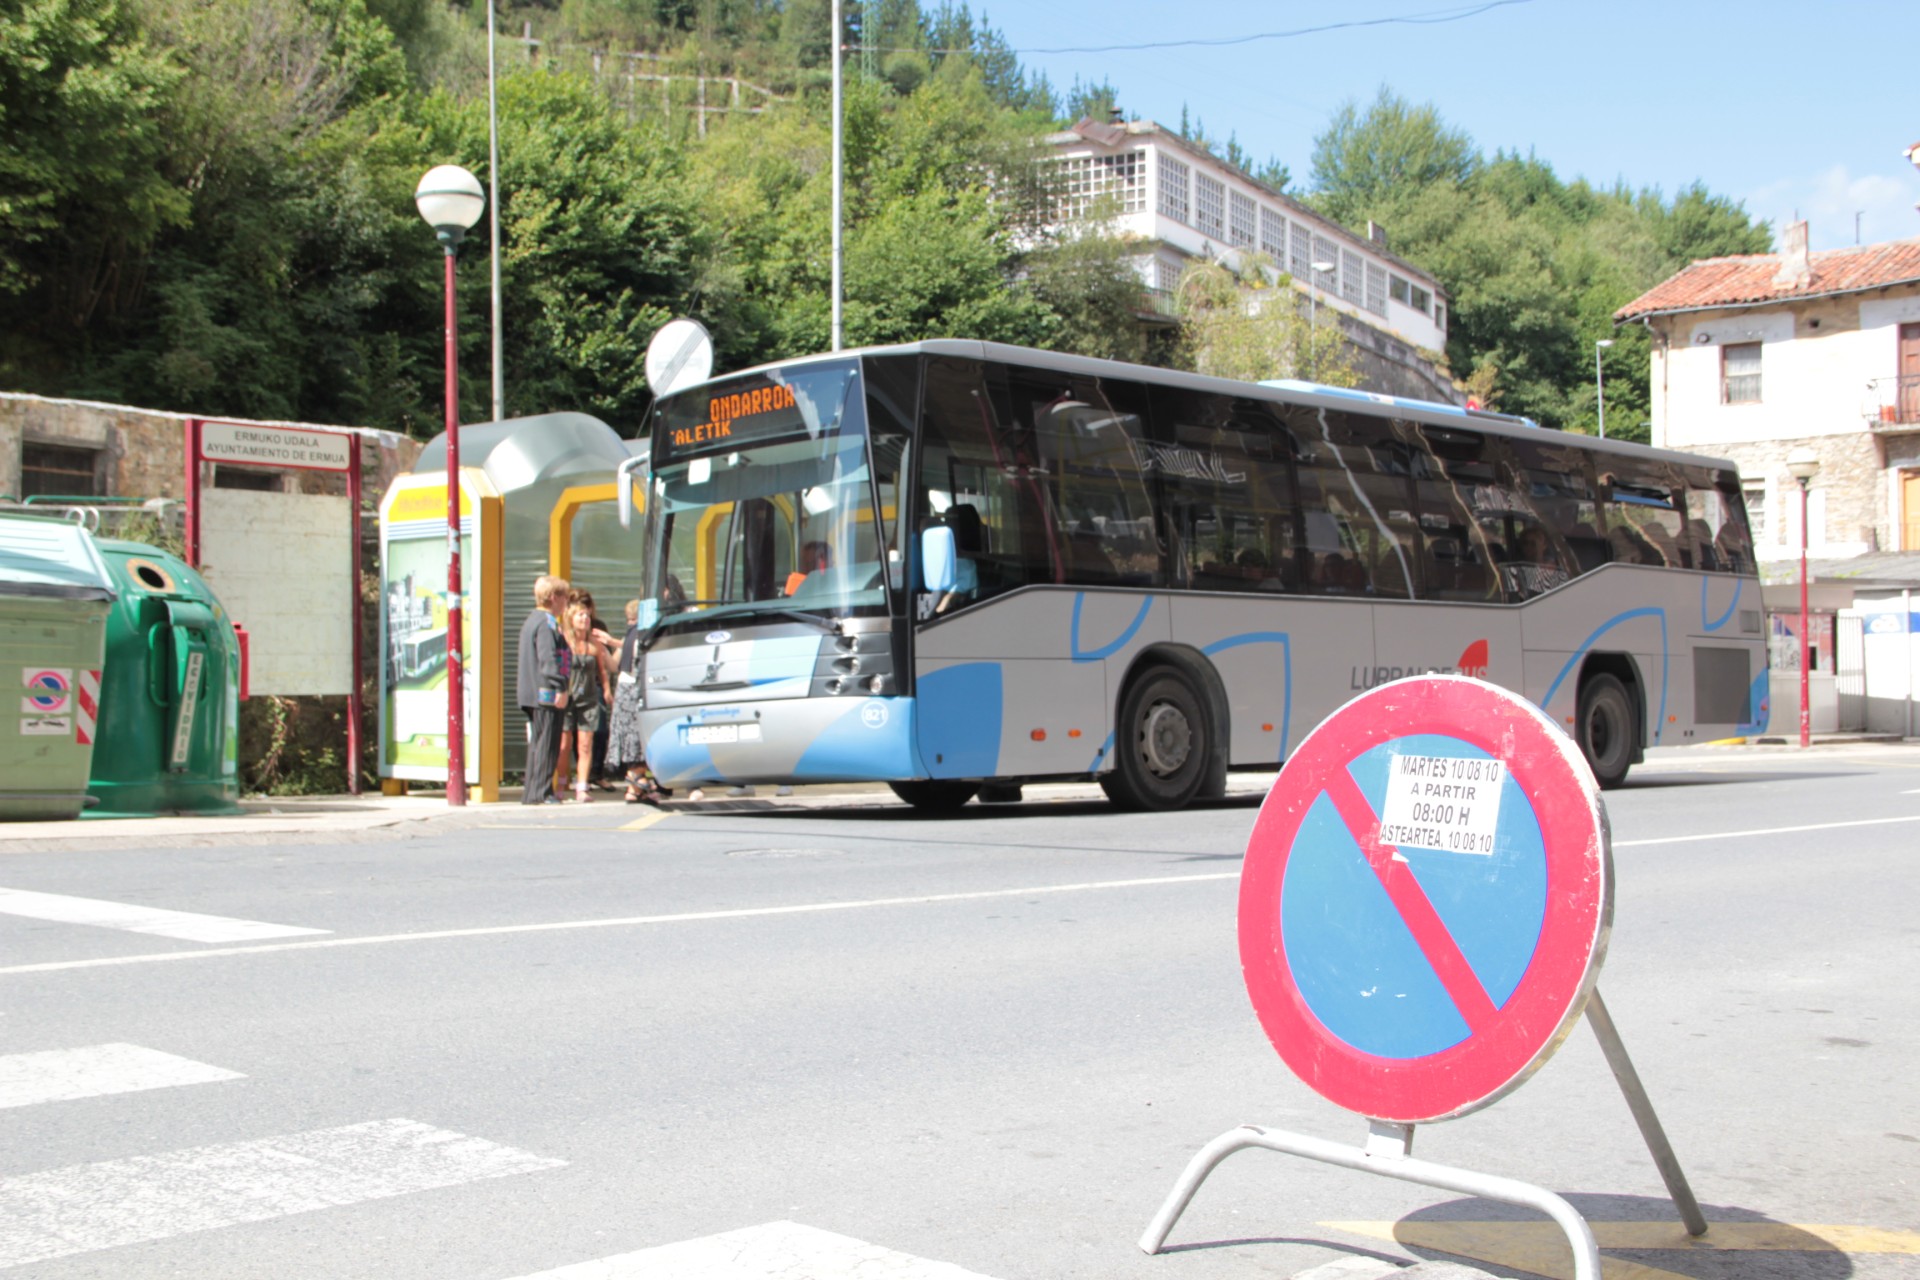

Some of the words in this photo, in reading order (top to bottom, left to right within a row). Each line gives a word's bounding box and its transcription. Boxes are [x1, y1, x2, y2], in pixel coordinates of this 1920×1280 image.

[710, 383, 795, 422] ONDARROA
[234, 430, 281, 444] ERMUKO
[284, 434, 319, 448] UDALA
[206, 443, 290, 459] AYUNTAMIENTO
[292, 450, 306, 461] DE
[309, 452, 346, 464] ERMUA
[1400, 756, 1448, 778] MARTES
[1410, 782, 1420, 795] A
[1424, 783, 1476, 800] PARTIR
[1412, 802, 1454, 824] 08:00
[1458, 806, 1471, 826] H
